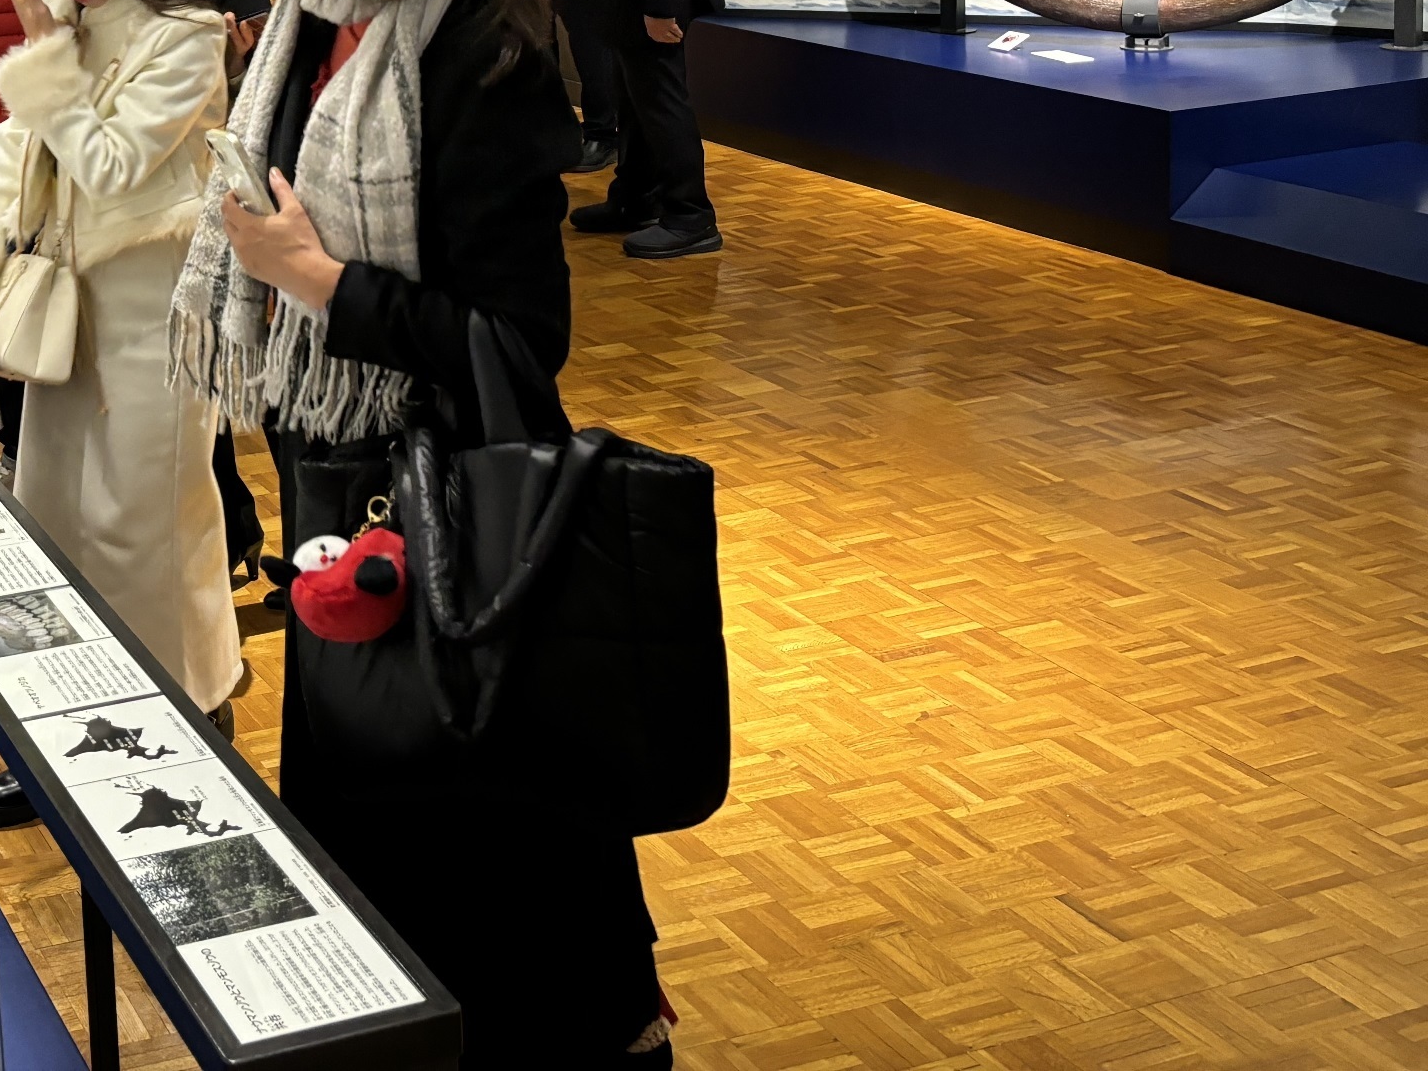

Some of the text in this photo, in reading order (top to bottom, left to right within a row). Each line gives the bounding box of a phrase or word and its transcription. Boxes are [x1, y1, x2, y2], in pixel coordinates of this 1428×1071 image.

[199, 946, 267, 1033] ナウマンゾウとマンモスゾウの
[269, 1012, 288, 1029] 共存
